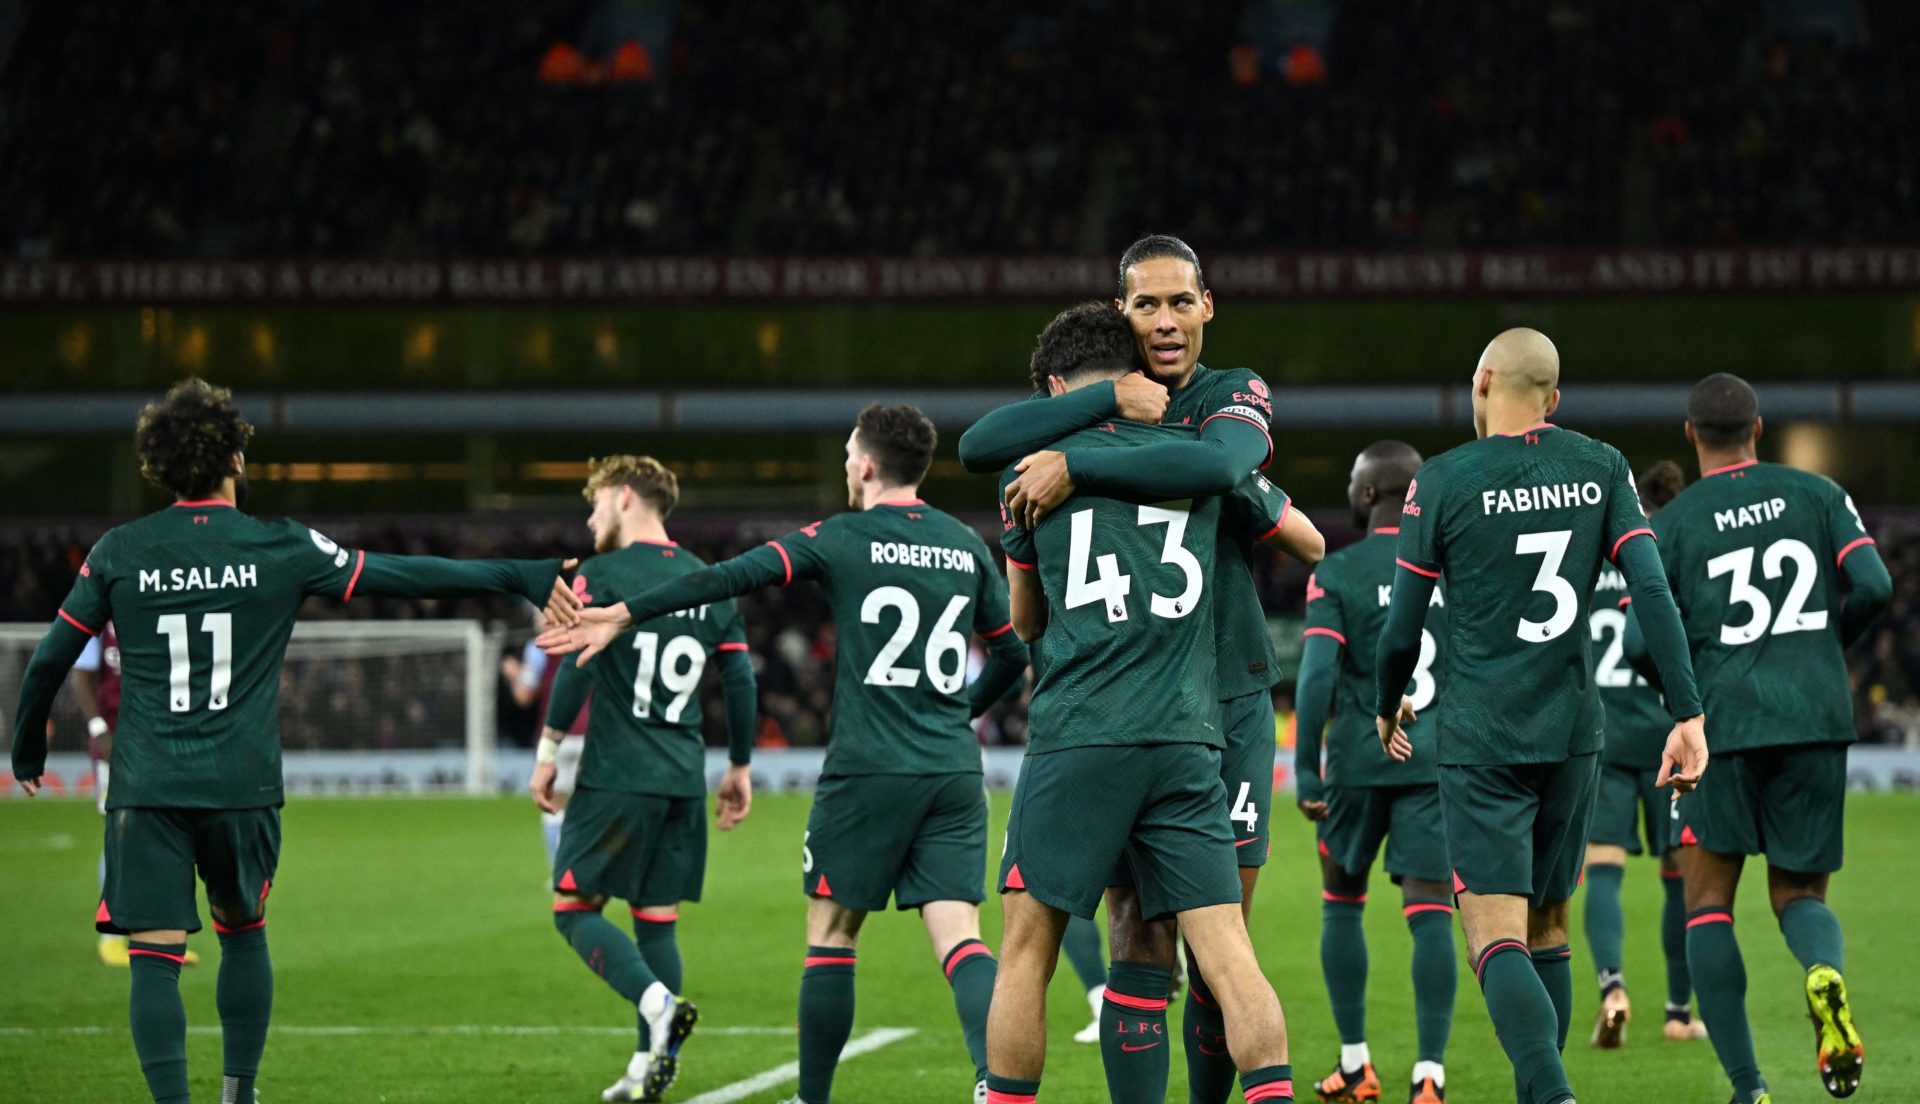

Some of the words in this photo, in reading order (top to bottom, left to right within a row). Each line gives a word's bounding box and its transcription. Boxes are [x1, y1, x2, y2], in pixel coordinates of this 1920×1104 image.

[308, 261, 441, 298] GOOD
[449, 261, 546, 298] BALL
[560, 260, 719, 297] PLAYED
[726, 260, 775, 295] IN
[784, 260, 869, 295] FOR
[998, 258, 1113, 294] MORL
[1811, 253, 1920, 289] PETE
[1482, 481, 1602, 515] FABINHO
[1714, 497, 1786, 532] MATIP
[870, 541, 975, 574] ROBERTSON
[1065, 498, 1203, 623] 43
[1515, 530, 1578, 643] 3
[1707, 538, 1829, 645] 32
[156, 612, 232, 712] 11
[632, 631, 707, 723] 19
[860, 586, 970, 695] 26
[1229, 782, 1258, 832] 4
